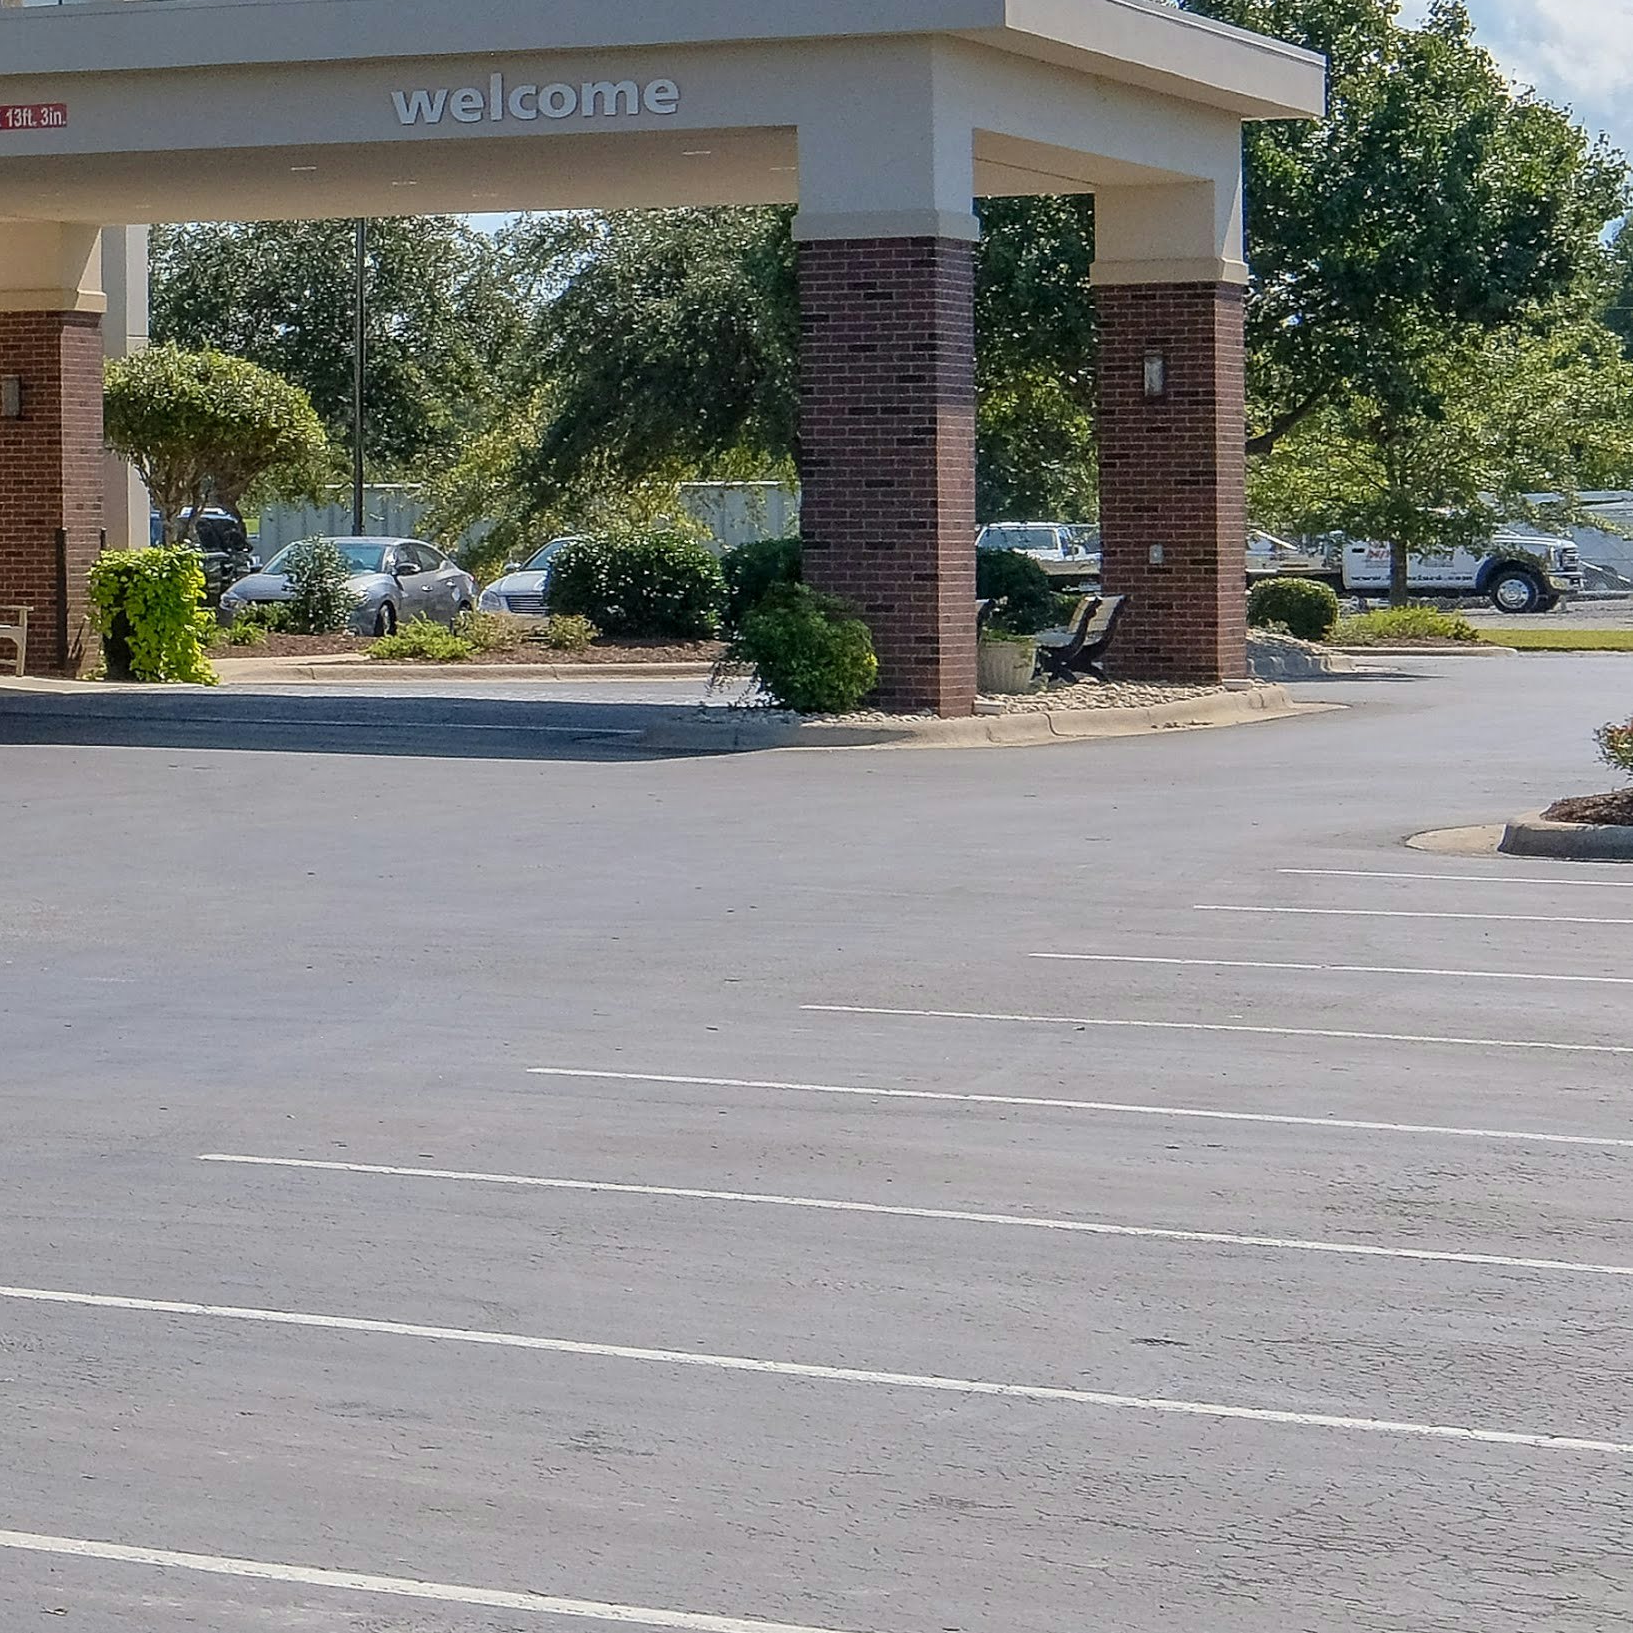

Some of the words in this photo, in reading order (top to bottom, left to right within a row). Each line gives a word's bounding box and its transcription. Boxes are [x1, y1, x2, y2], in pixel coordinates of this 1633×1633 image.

[6, 108, 37, 128] 13ft.
[40, 106, 67, 126] 3in.
[391, 72, 680, 125] welcome
